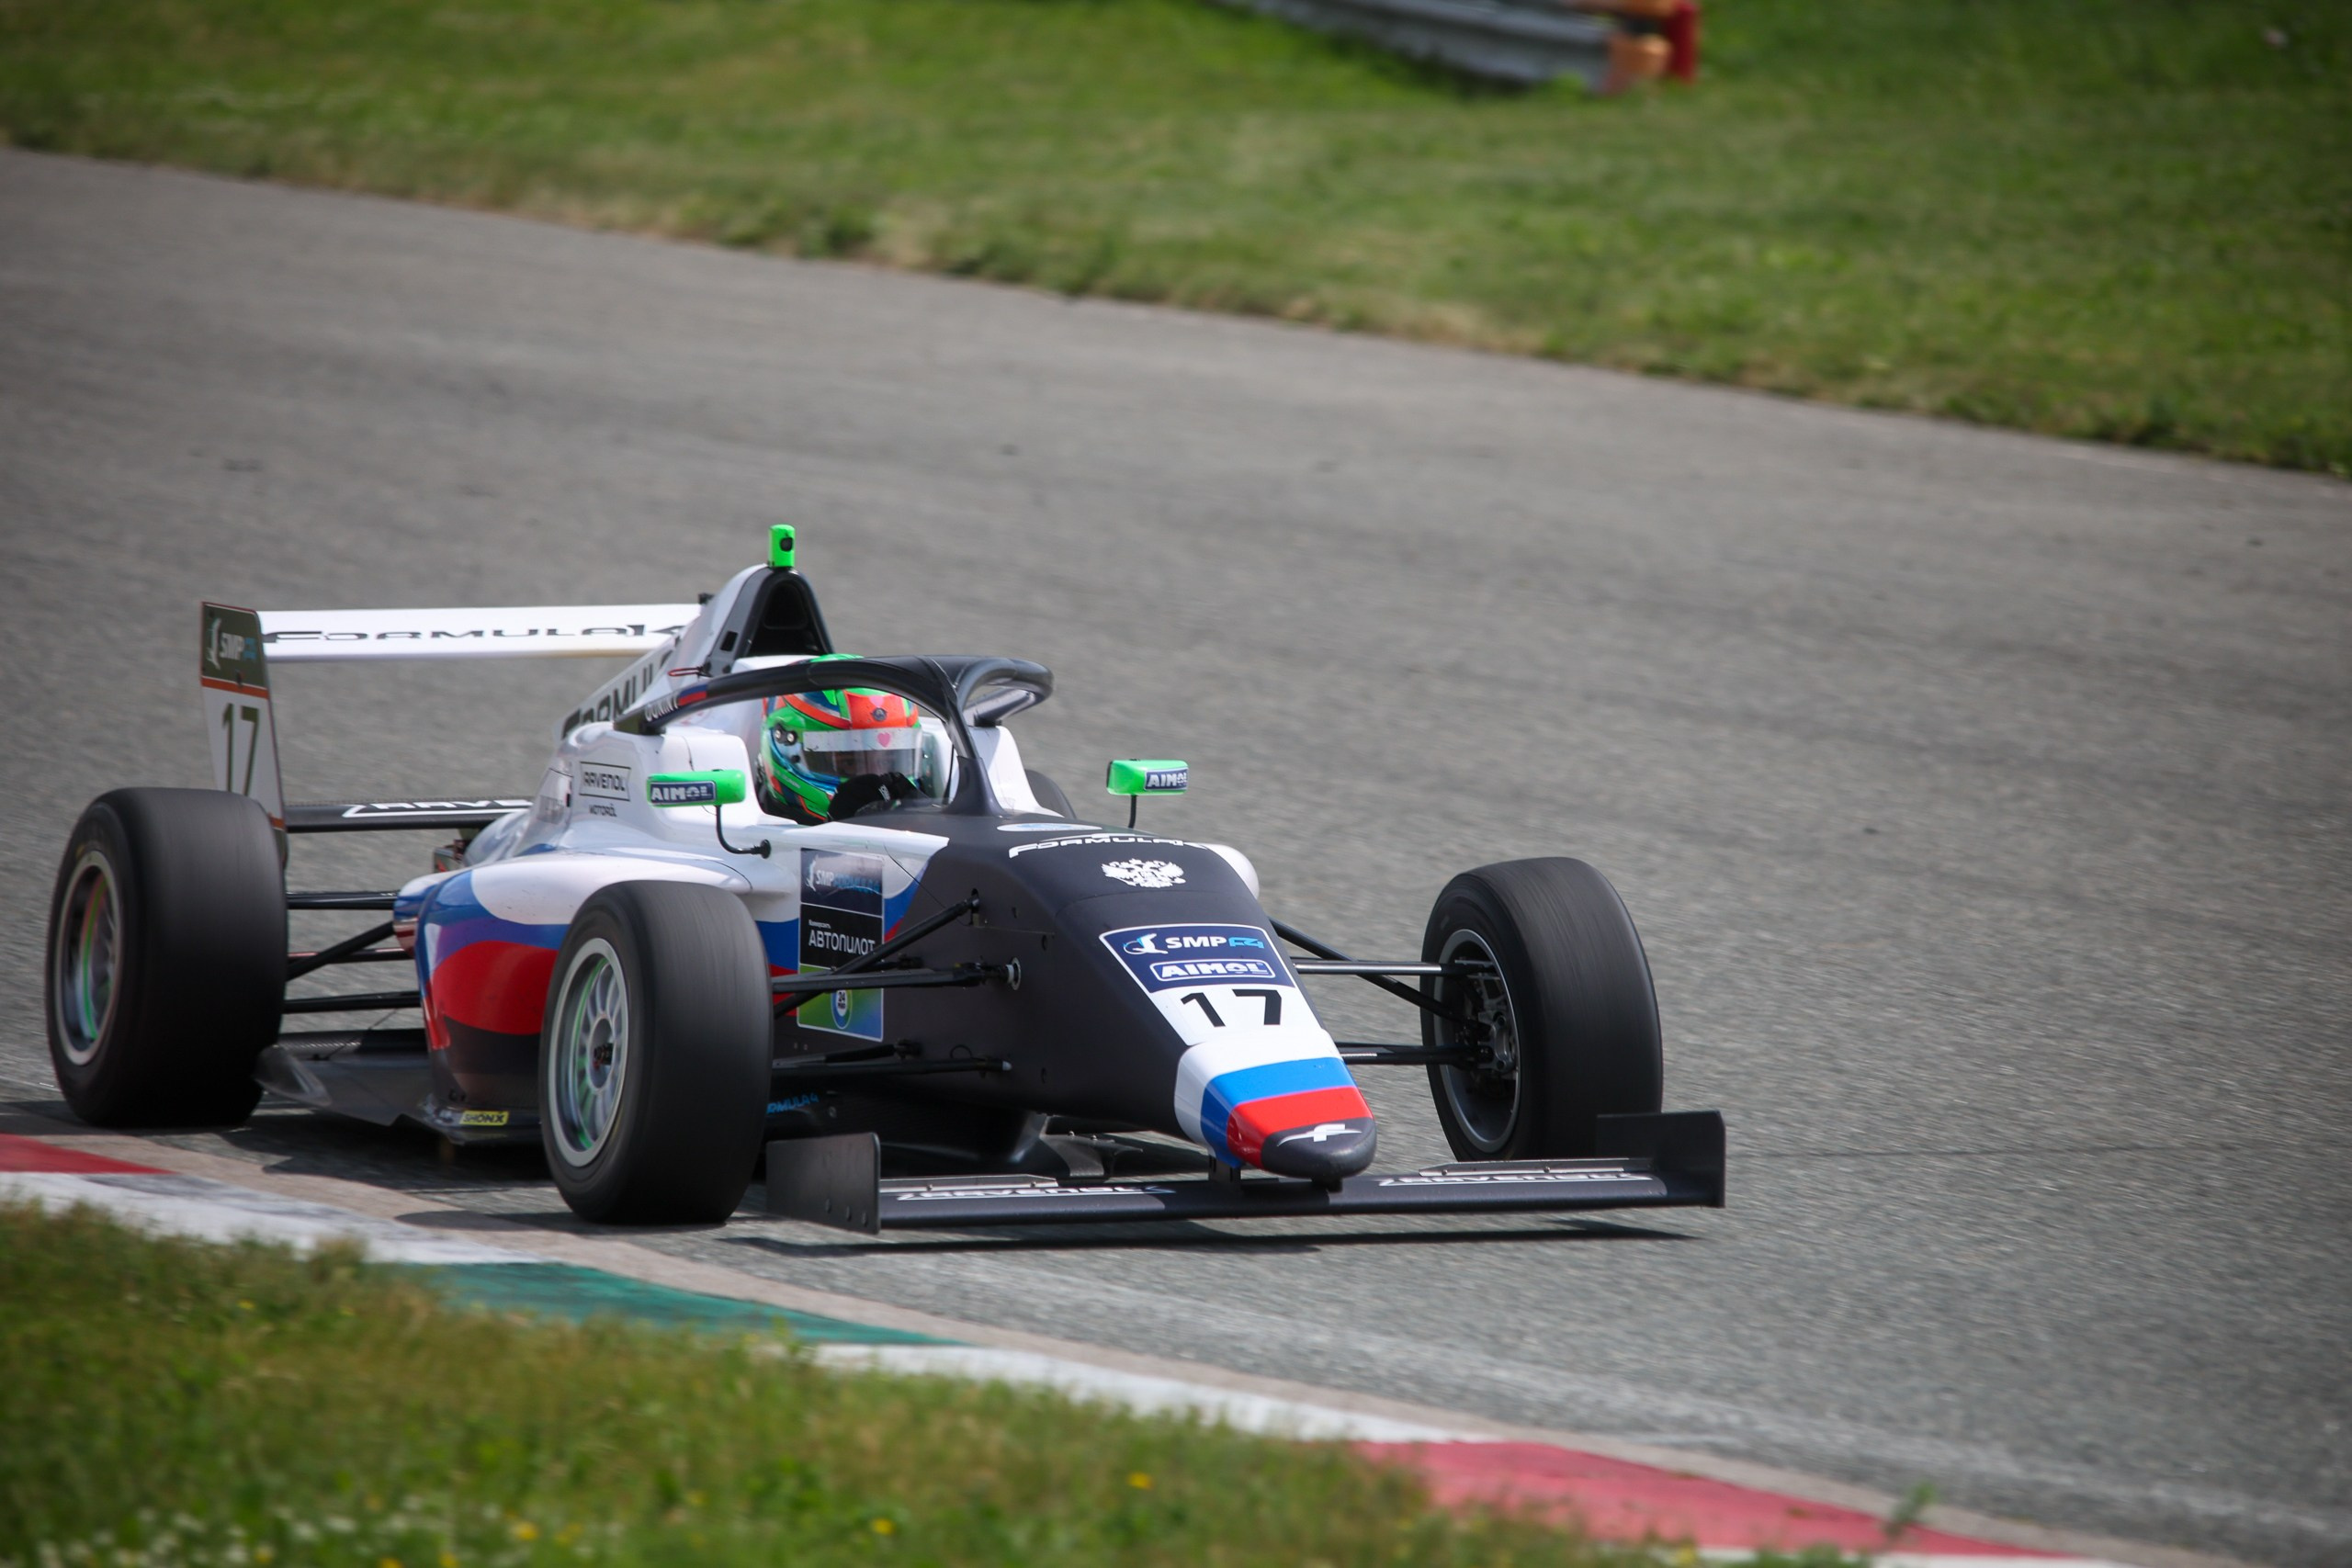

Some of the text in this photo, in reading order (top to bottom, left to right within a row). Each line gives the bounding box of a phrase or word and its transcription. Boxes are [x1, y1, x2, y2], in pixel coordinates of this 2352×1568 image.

[222, 702, 260, 798] 17
[650, 785, 713, 802] AIMOL
[808, 929, 876, 956] АВТОПИЛОТ
[1165, 935, 1227, 950] SMP
[1161, 962, 1270, 979] AIMOL
[1180, 987, 1283, 1029] 17
